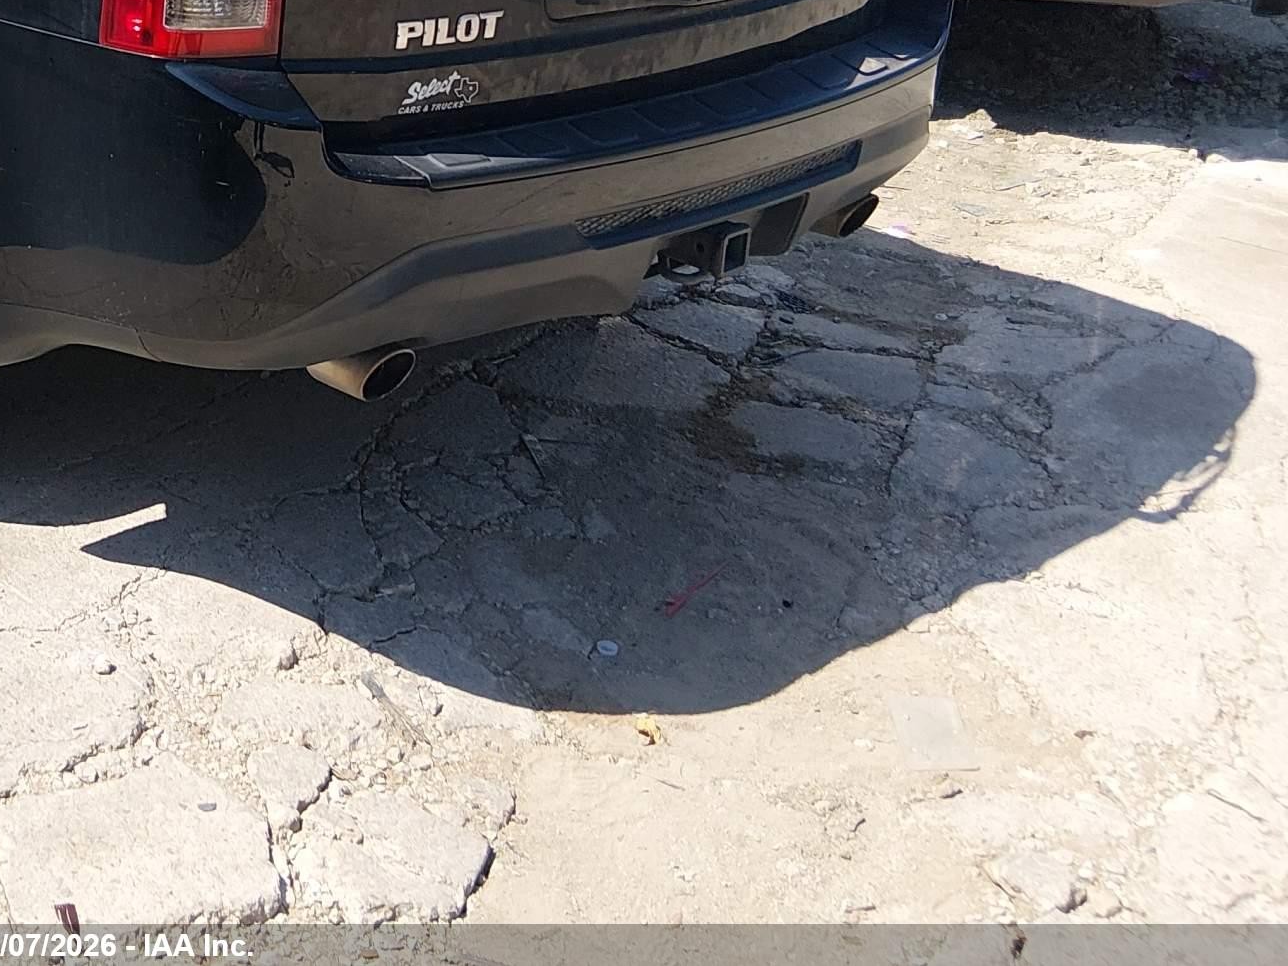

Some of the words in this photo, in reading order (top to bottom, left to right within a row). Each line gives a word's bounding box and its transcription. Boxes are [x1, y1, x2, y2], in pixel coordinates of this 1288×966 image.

[395, 10, 505, 50] PILOT
[402, 70, 461, 105] Select
[398, 103, 421, 114] CARS
[431, 100, 465, 111] TRUCKS
